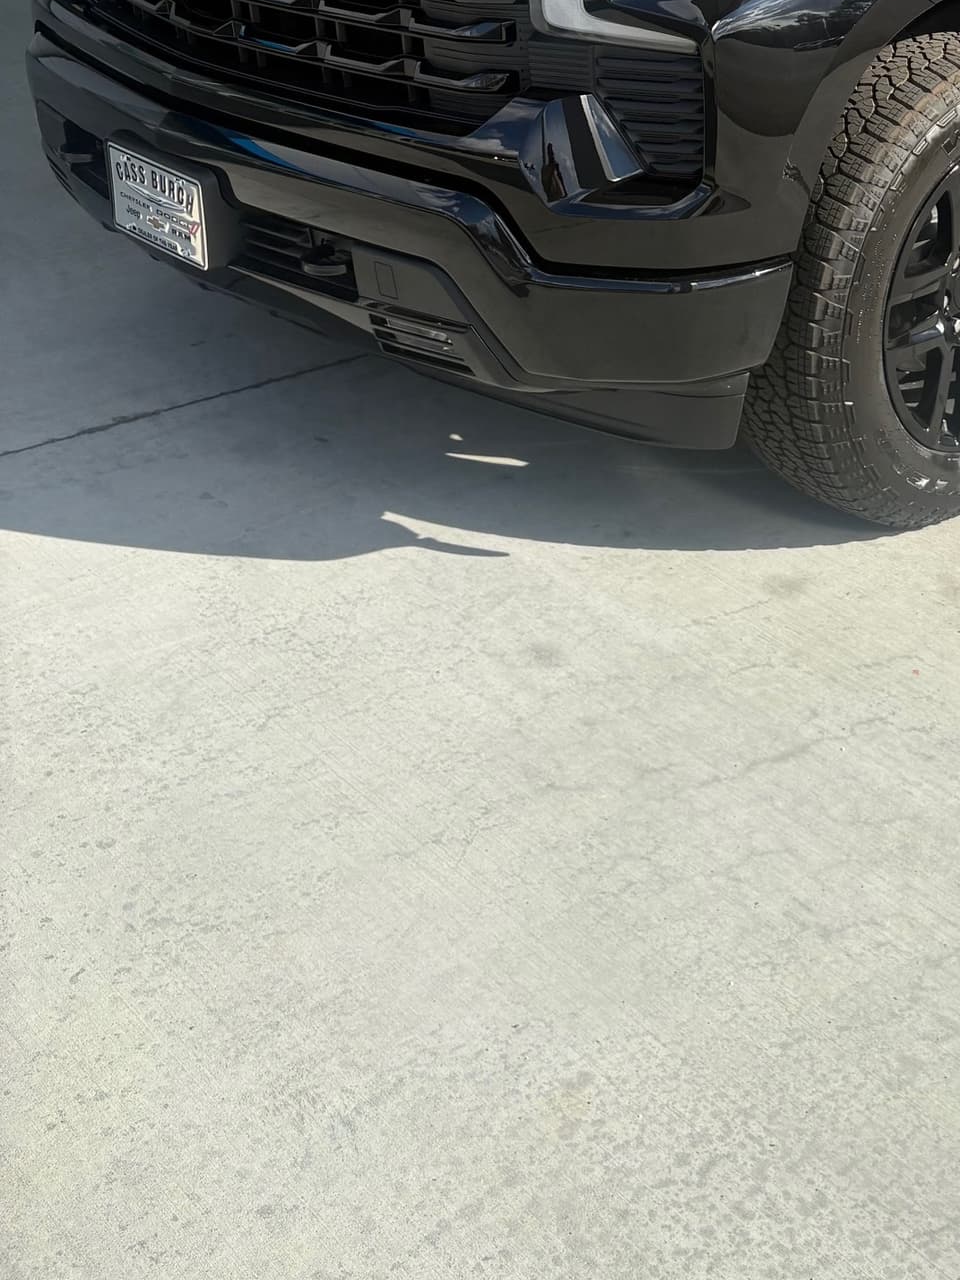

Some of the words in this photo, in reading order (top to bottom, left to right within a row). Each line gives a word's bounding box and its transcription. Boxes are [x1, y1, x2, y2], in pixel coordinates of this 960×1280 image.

[115, 160, 146, 185] CASS
[151, 170, 194, 217] BURCH
[120, 191, 151, 210] CHRYSLER
[126, 205, 142, 220] Jeep
[171, 228, 191, 242] RAM
